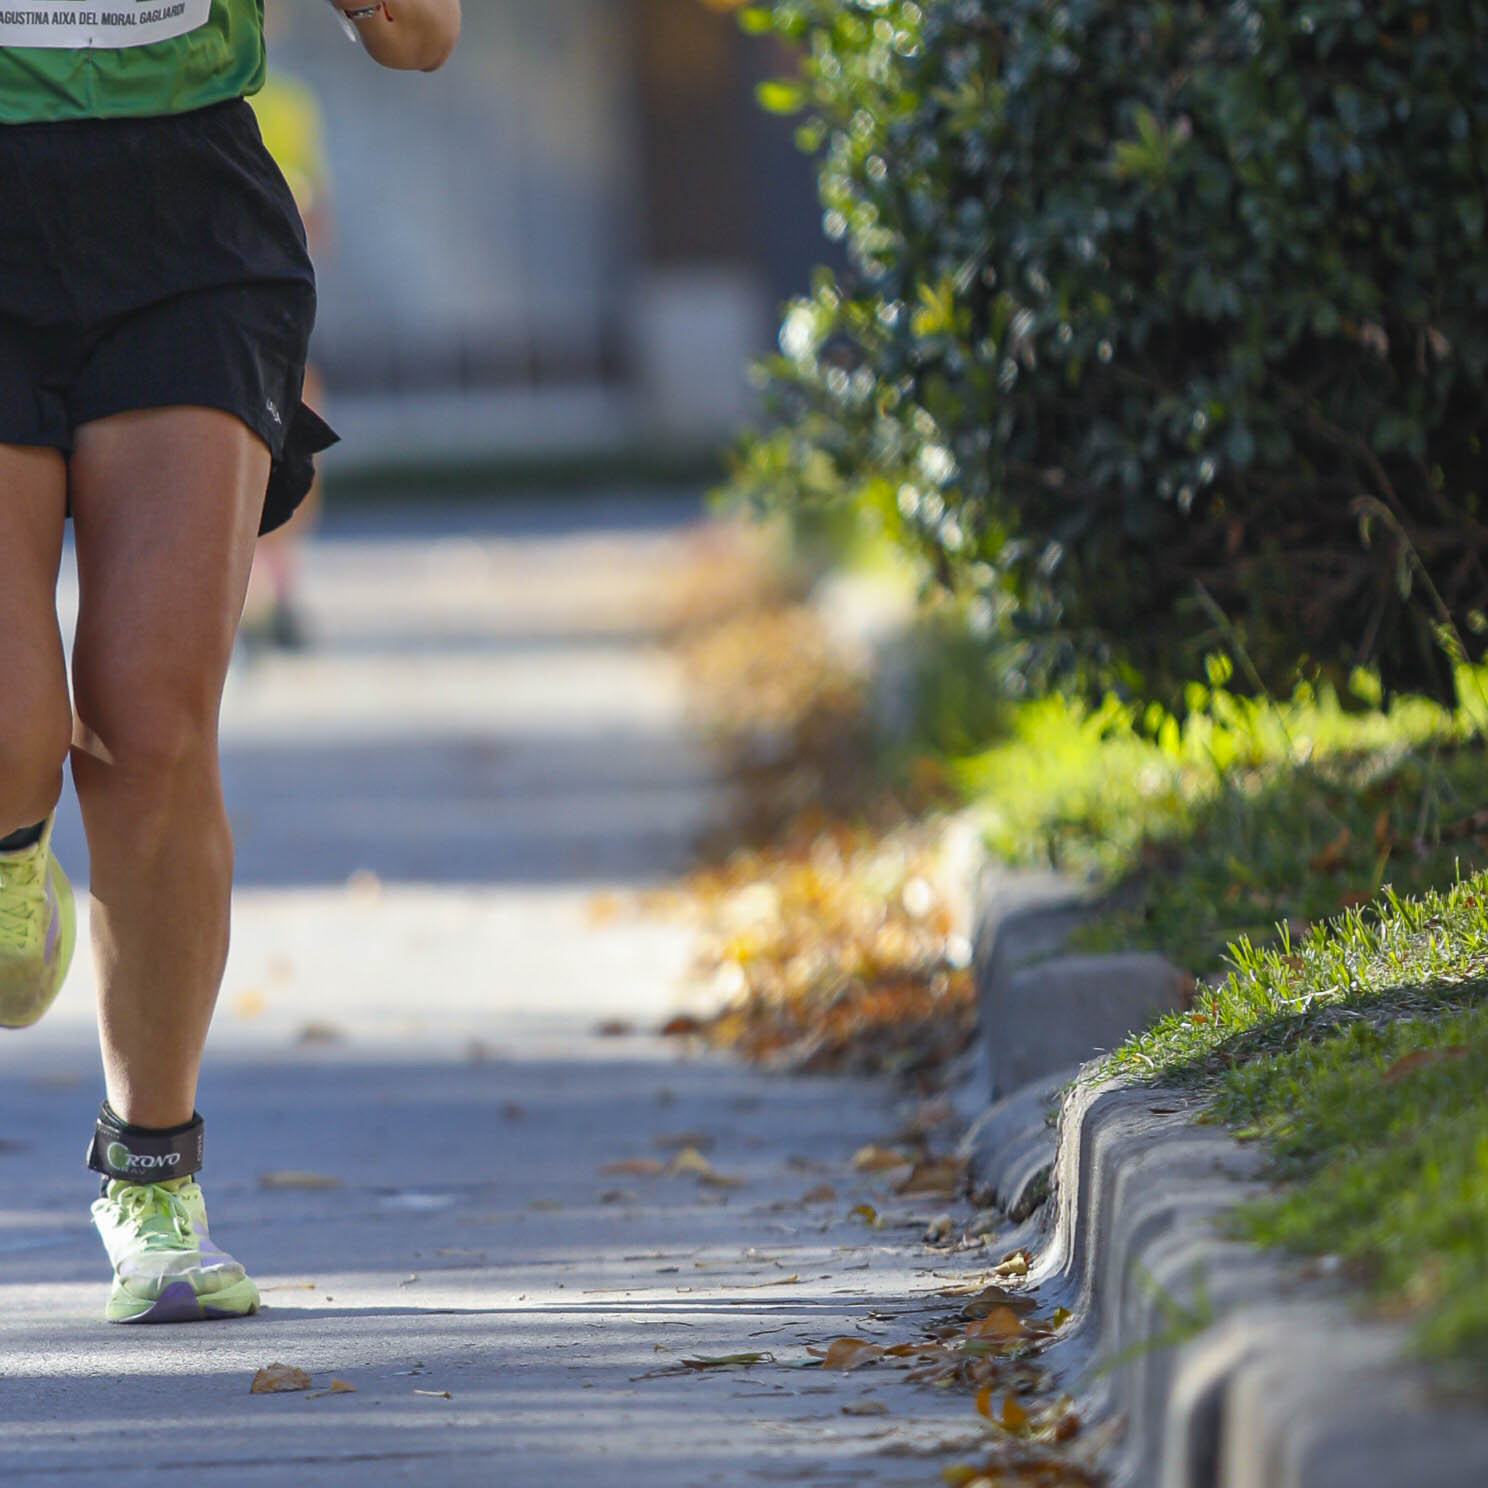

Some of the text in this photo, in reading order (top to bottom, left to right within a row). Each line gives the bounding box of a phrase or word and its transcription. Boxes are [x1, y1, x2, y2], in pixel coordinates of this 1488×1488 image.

[52, 12, 77, 25] AIXA
[79, 12, 99, 25] DEL
[101, 13, 137, 26] MORAL
[139, 2, 185, 24] GAGLIARDI
